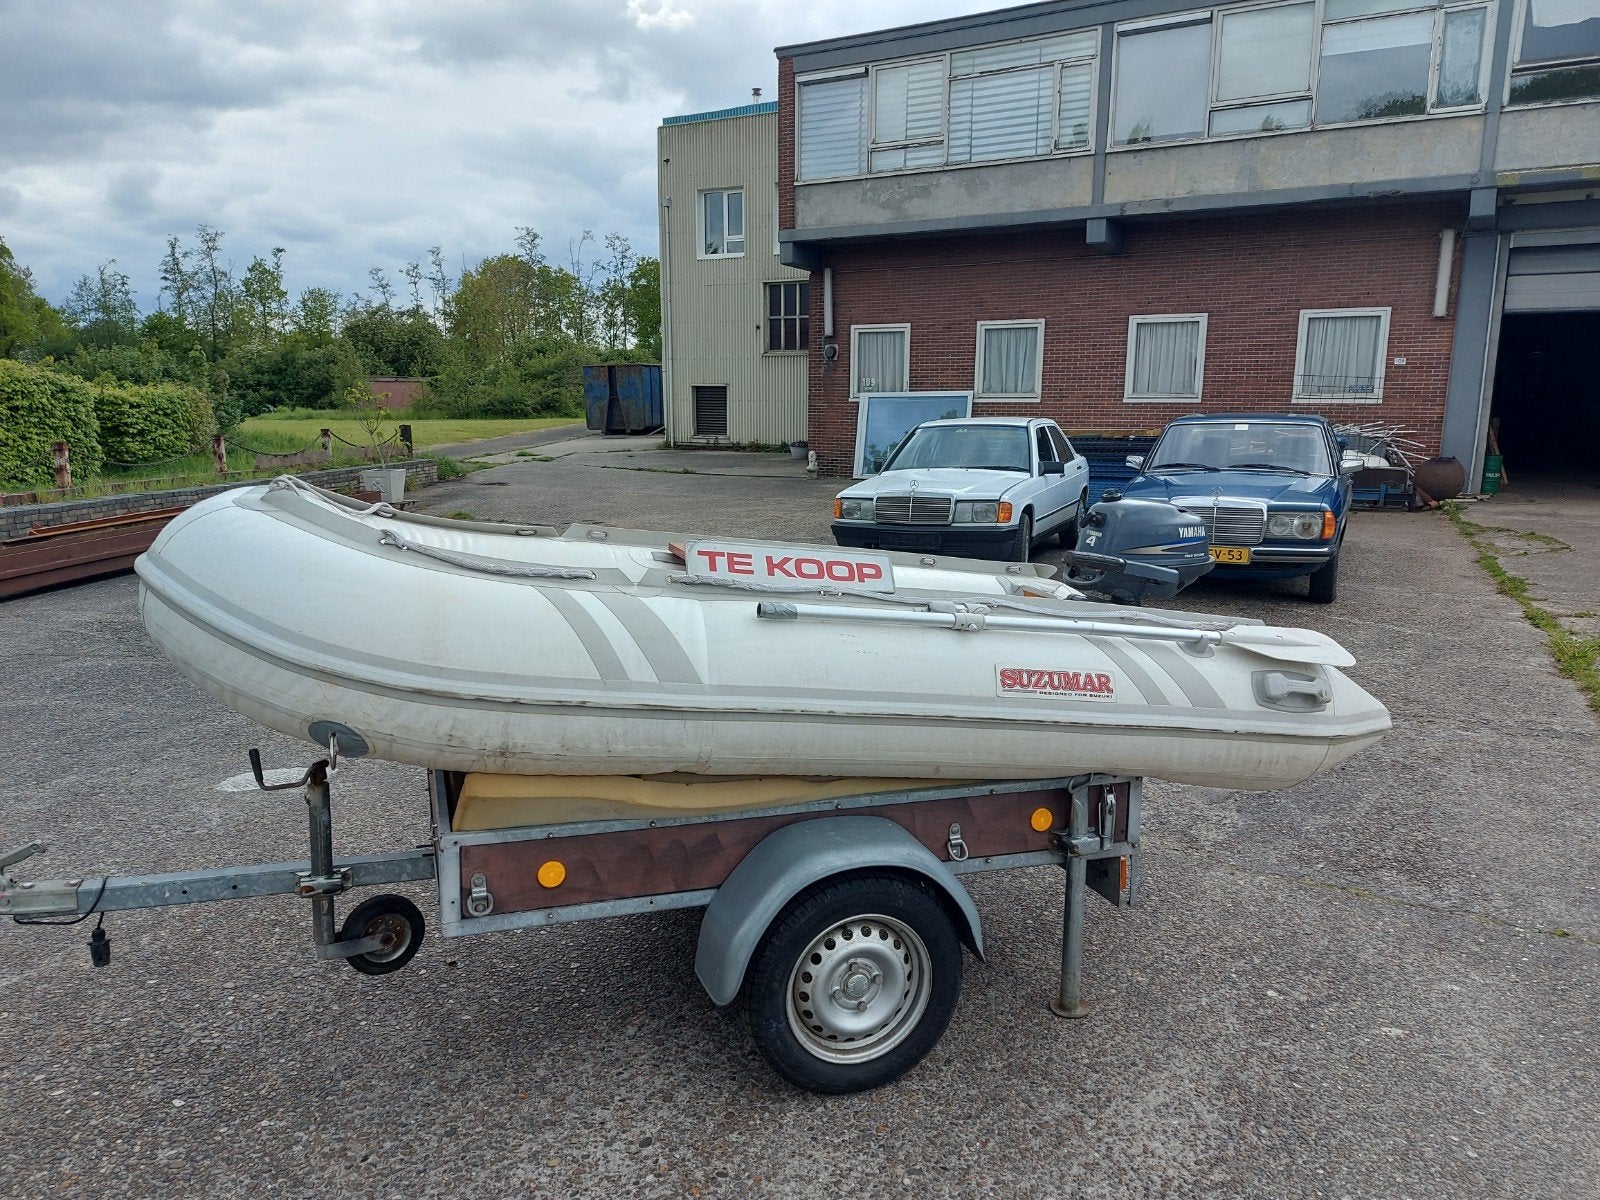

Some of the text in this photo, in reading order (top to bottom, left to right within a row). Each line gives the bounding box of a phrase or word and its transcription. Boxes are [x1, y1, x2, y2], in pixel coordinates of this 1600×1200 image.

[862, 377, 876, 387] 109
[1178, 525, 1206, 538] YAMAHA
[1085, 535, 1096, 547] 4
[696, 550, 883, 583] TE KOOP
[1000, 667, 1114, 694] SUZUMAR
